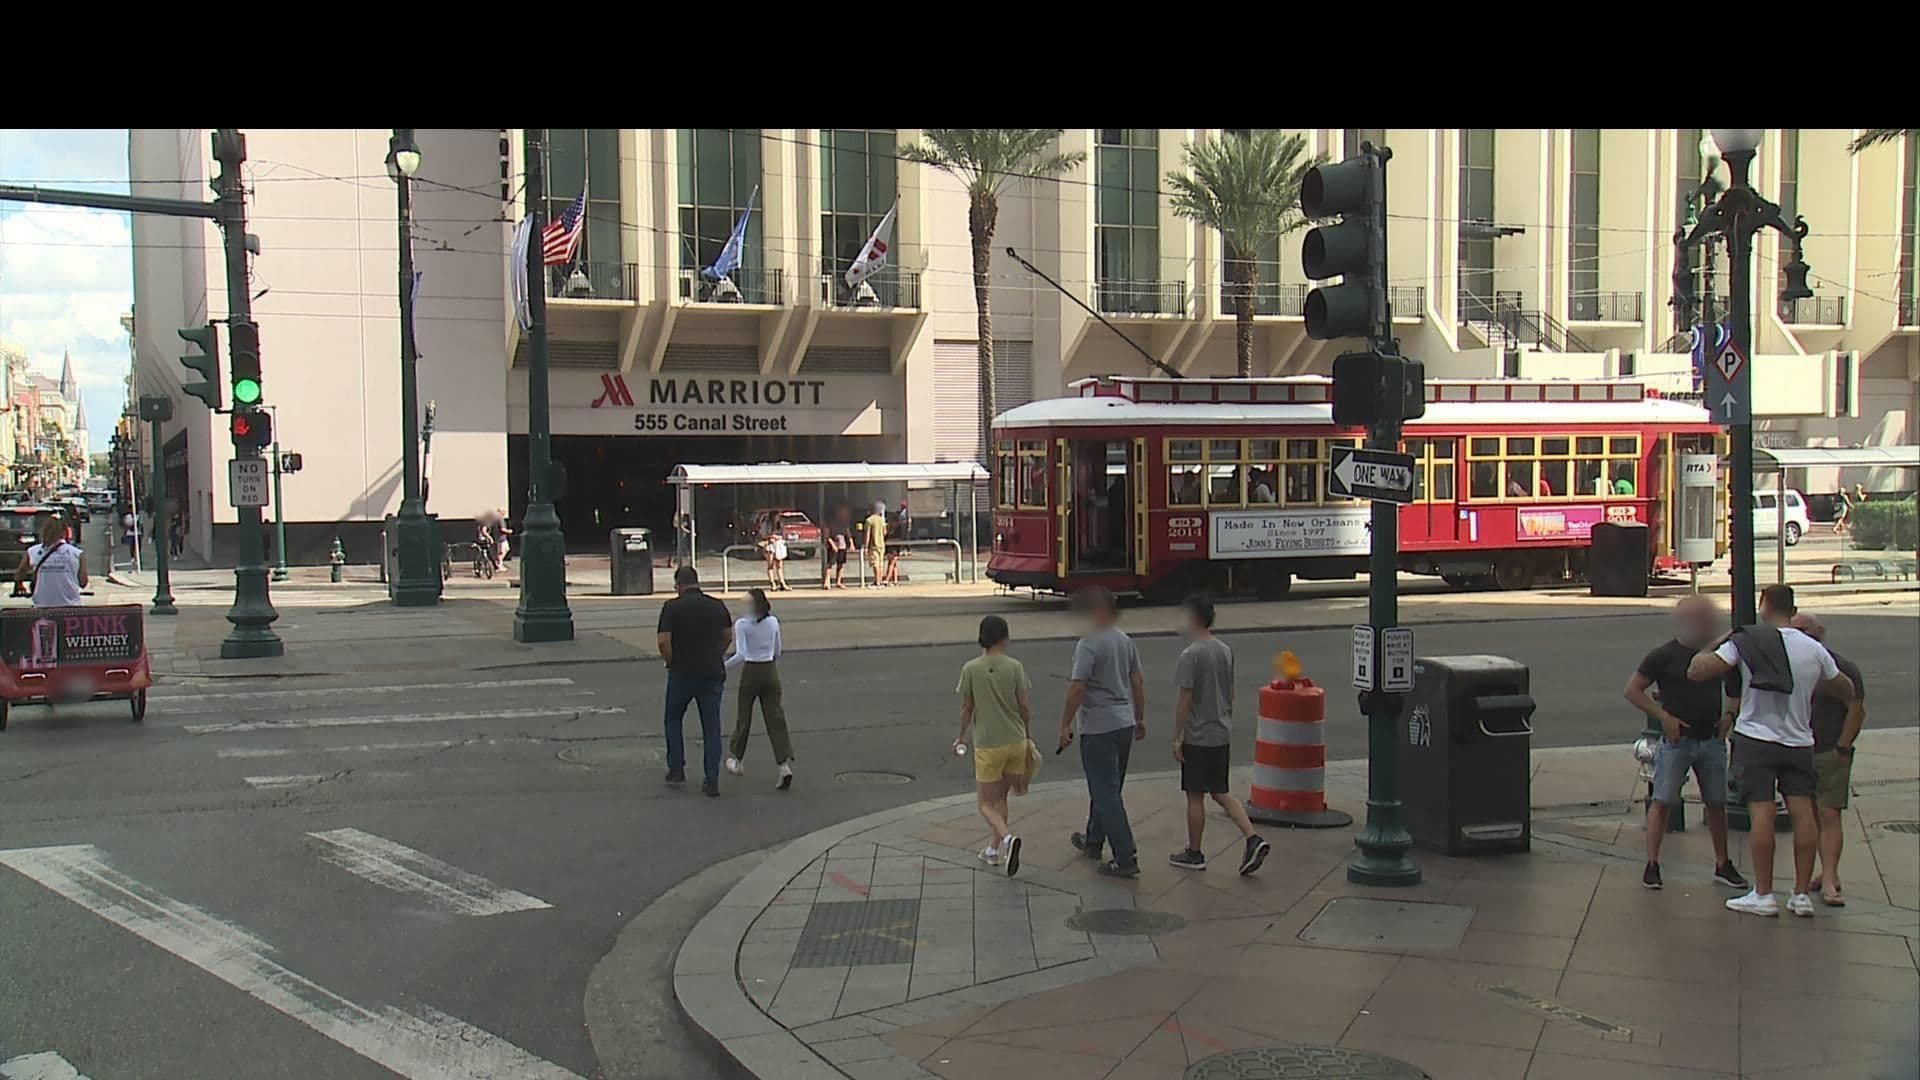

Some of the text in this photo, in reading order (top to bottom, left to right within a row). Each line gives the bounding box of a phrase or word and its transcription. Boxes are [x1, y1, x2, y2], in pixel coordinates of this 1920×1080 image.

[1725, 352, 1736, 373] P
[650, 379, 825, 405] MARRIOTT
[634, 414, 787, 431] 555 Canal Street
[239, 463, 259, 473] NO
[1686, 463, 1705, 473] RTA
[237, 475, 261, 483] TURN
[1353, 464, 1405, 484] ONE WAY
[242, 485, 257, 493] ON
[241, 495, 260, 503] RED
[1224, 517, 1361, 530] Made In New Orleans
[1167, 527, 1202, 537] 2014
[1302, 528, 1326, 536] 1997
[63, 615, 129, 636] PINK
[65, 634, 129, 648] WHITNEY
